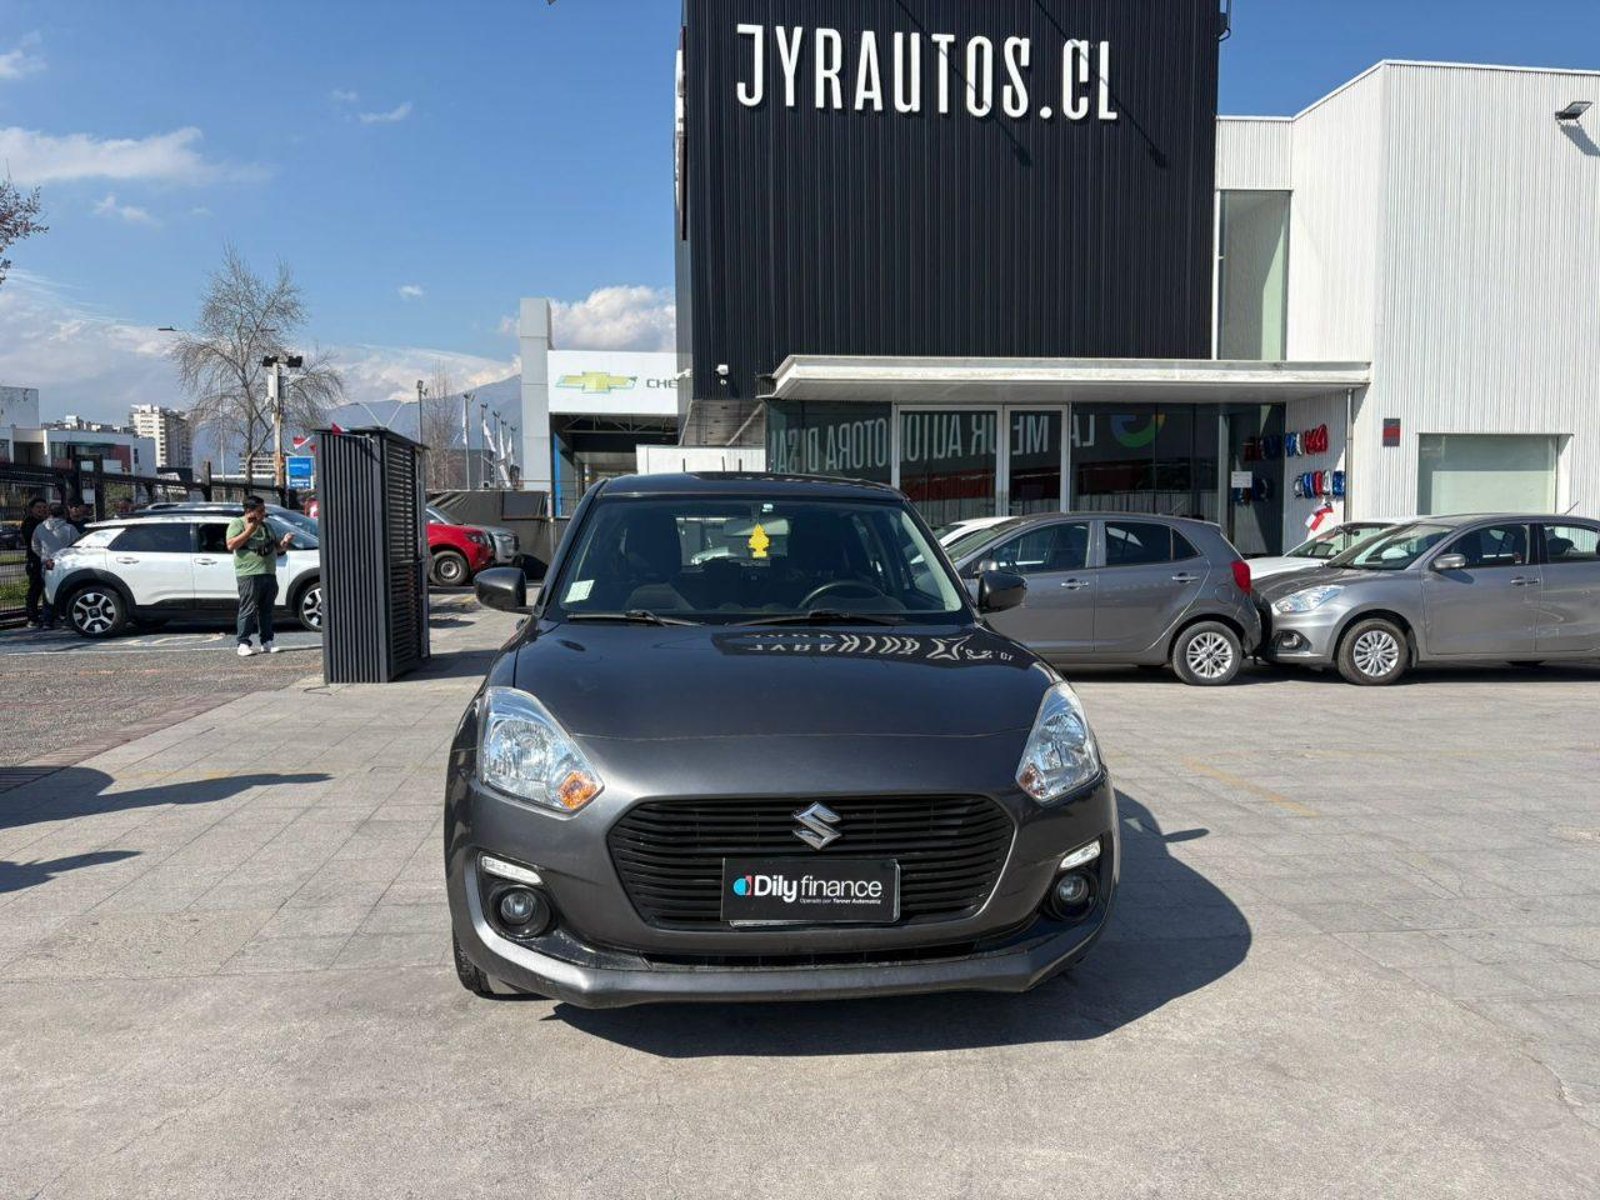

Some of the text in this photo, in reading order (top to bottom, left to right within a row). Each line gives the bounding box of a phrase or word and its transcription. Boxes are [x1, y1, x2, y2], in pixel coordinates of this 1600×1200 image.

[737, 23, 1118, 120] JYRAUTOS.CL
[754, 875, 882, 903] Dily finance
